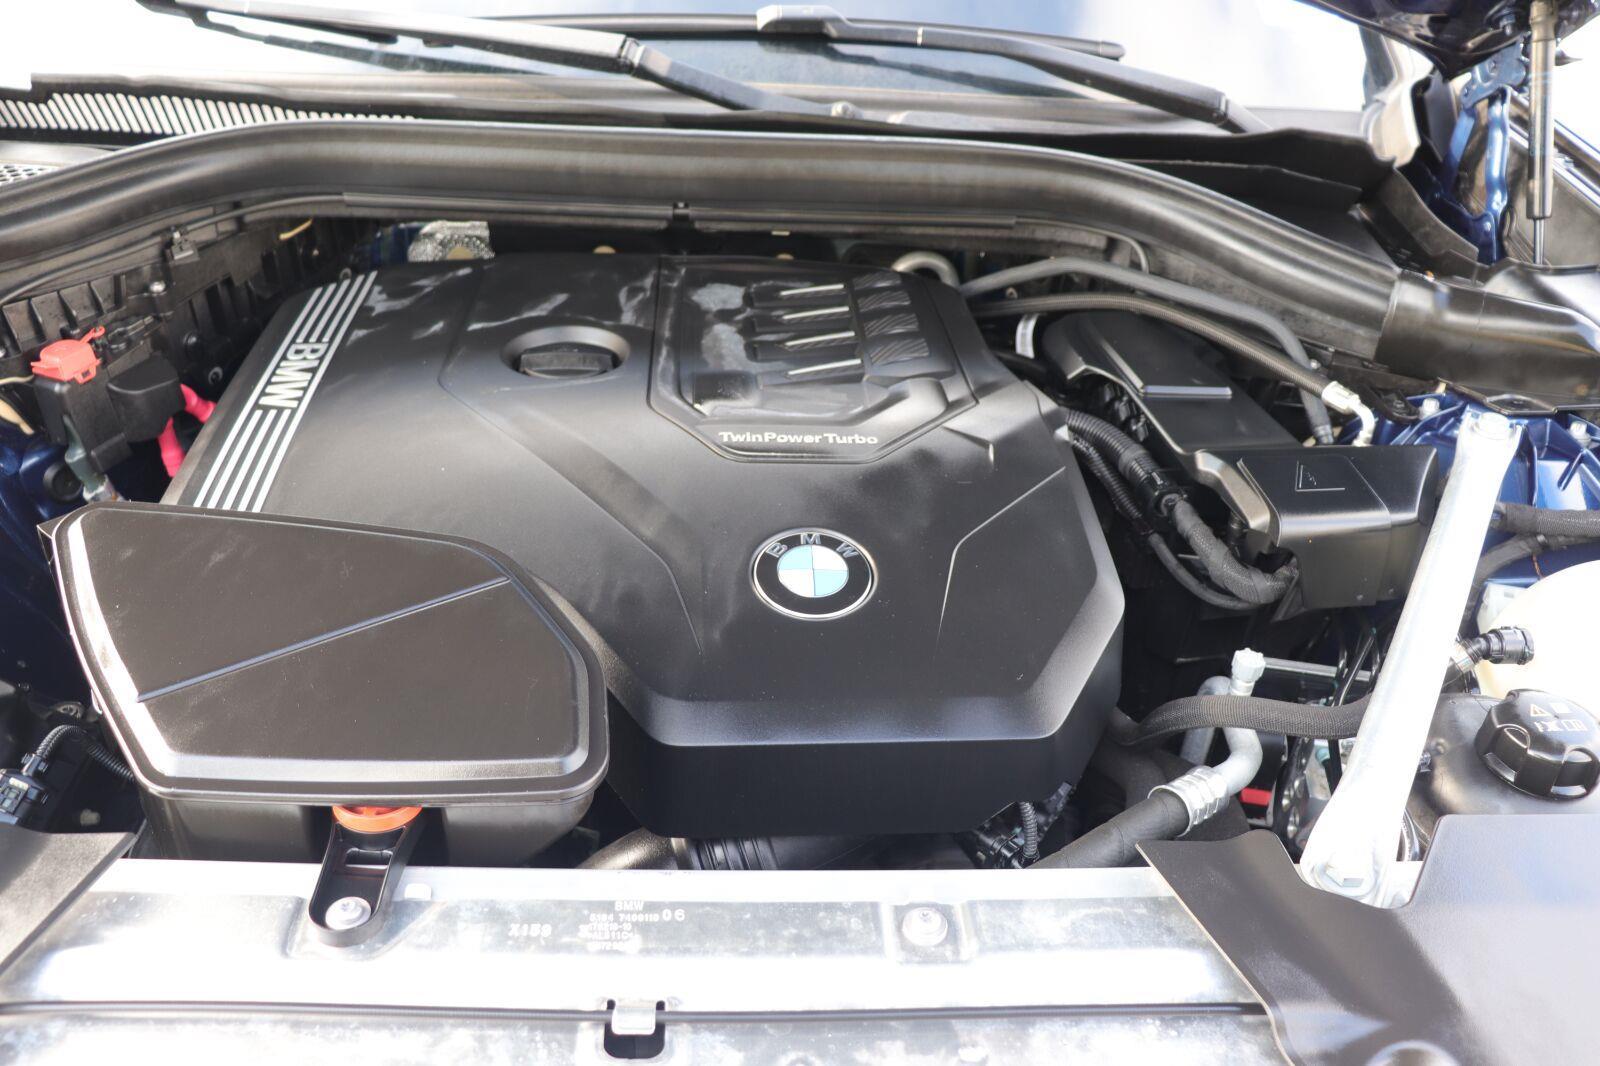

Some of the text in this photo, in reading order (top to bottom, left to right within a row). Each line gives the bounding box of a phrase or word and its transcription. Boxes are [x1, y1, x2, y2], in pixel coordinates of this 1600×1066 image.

[257, 342, 329, 409] BMW
[765, 532, 860, 559] BMW
[614, 900, 644, 911] BMW
